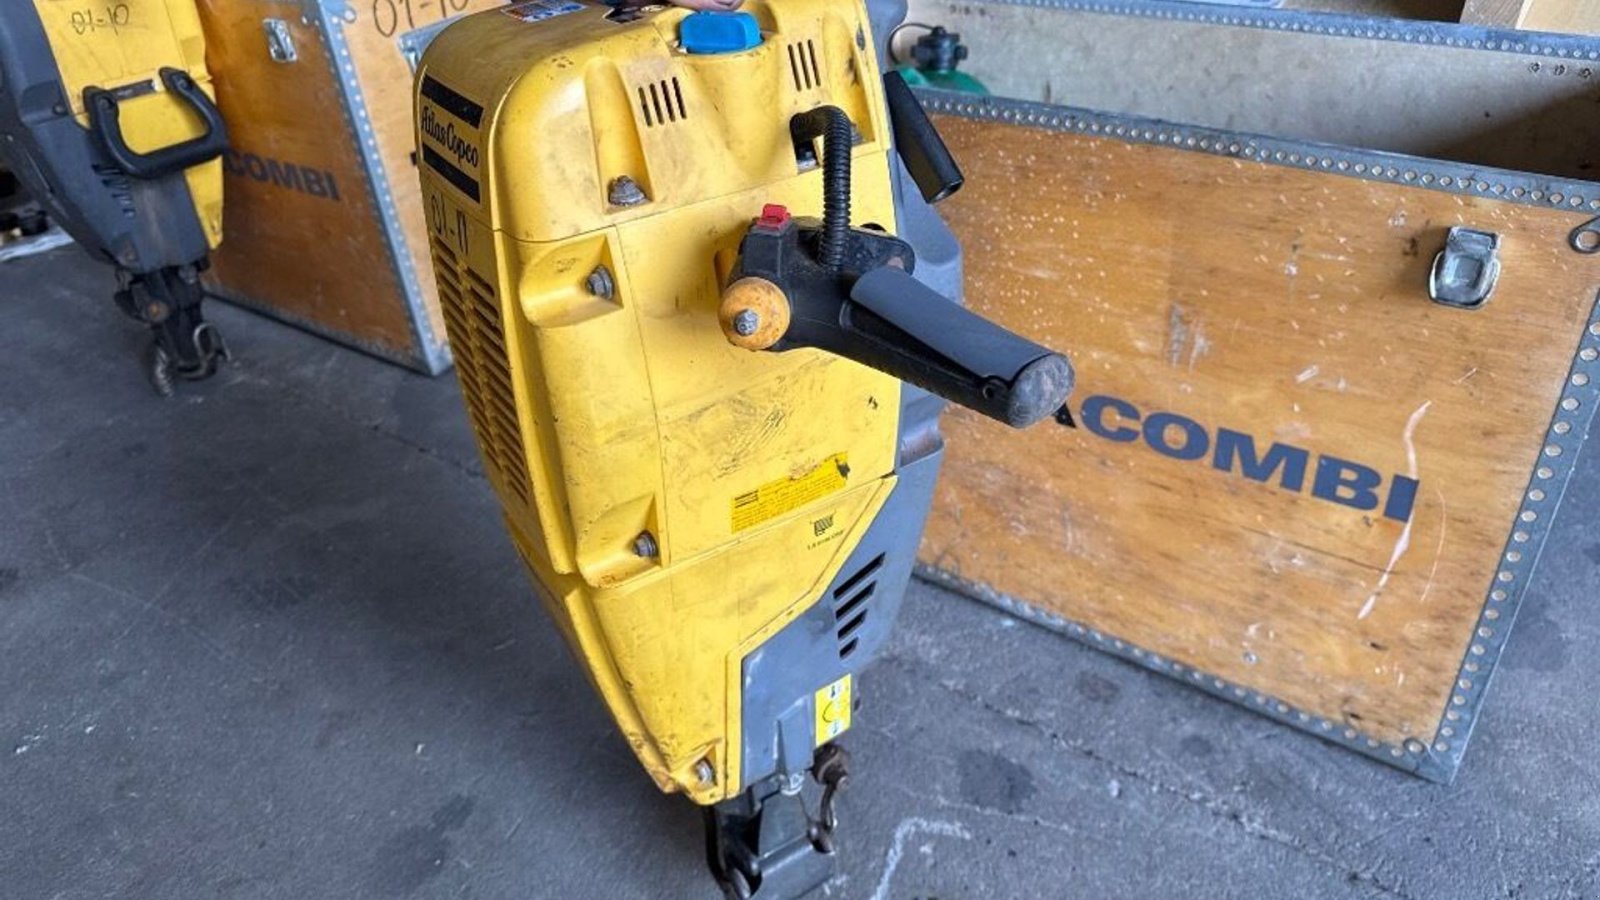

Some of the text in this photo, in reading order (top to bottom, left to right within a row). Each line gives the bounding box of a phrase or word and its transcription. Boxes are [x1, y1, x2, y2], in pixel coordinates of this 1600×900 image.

[71, 3, 129, 36] 01-10
[373, 0, 468, 37] 01-1
[420, 105, 479, 168] Atlas Copco
[1054, 394, 1420, 523] COMBI
